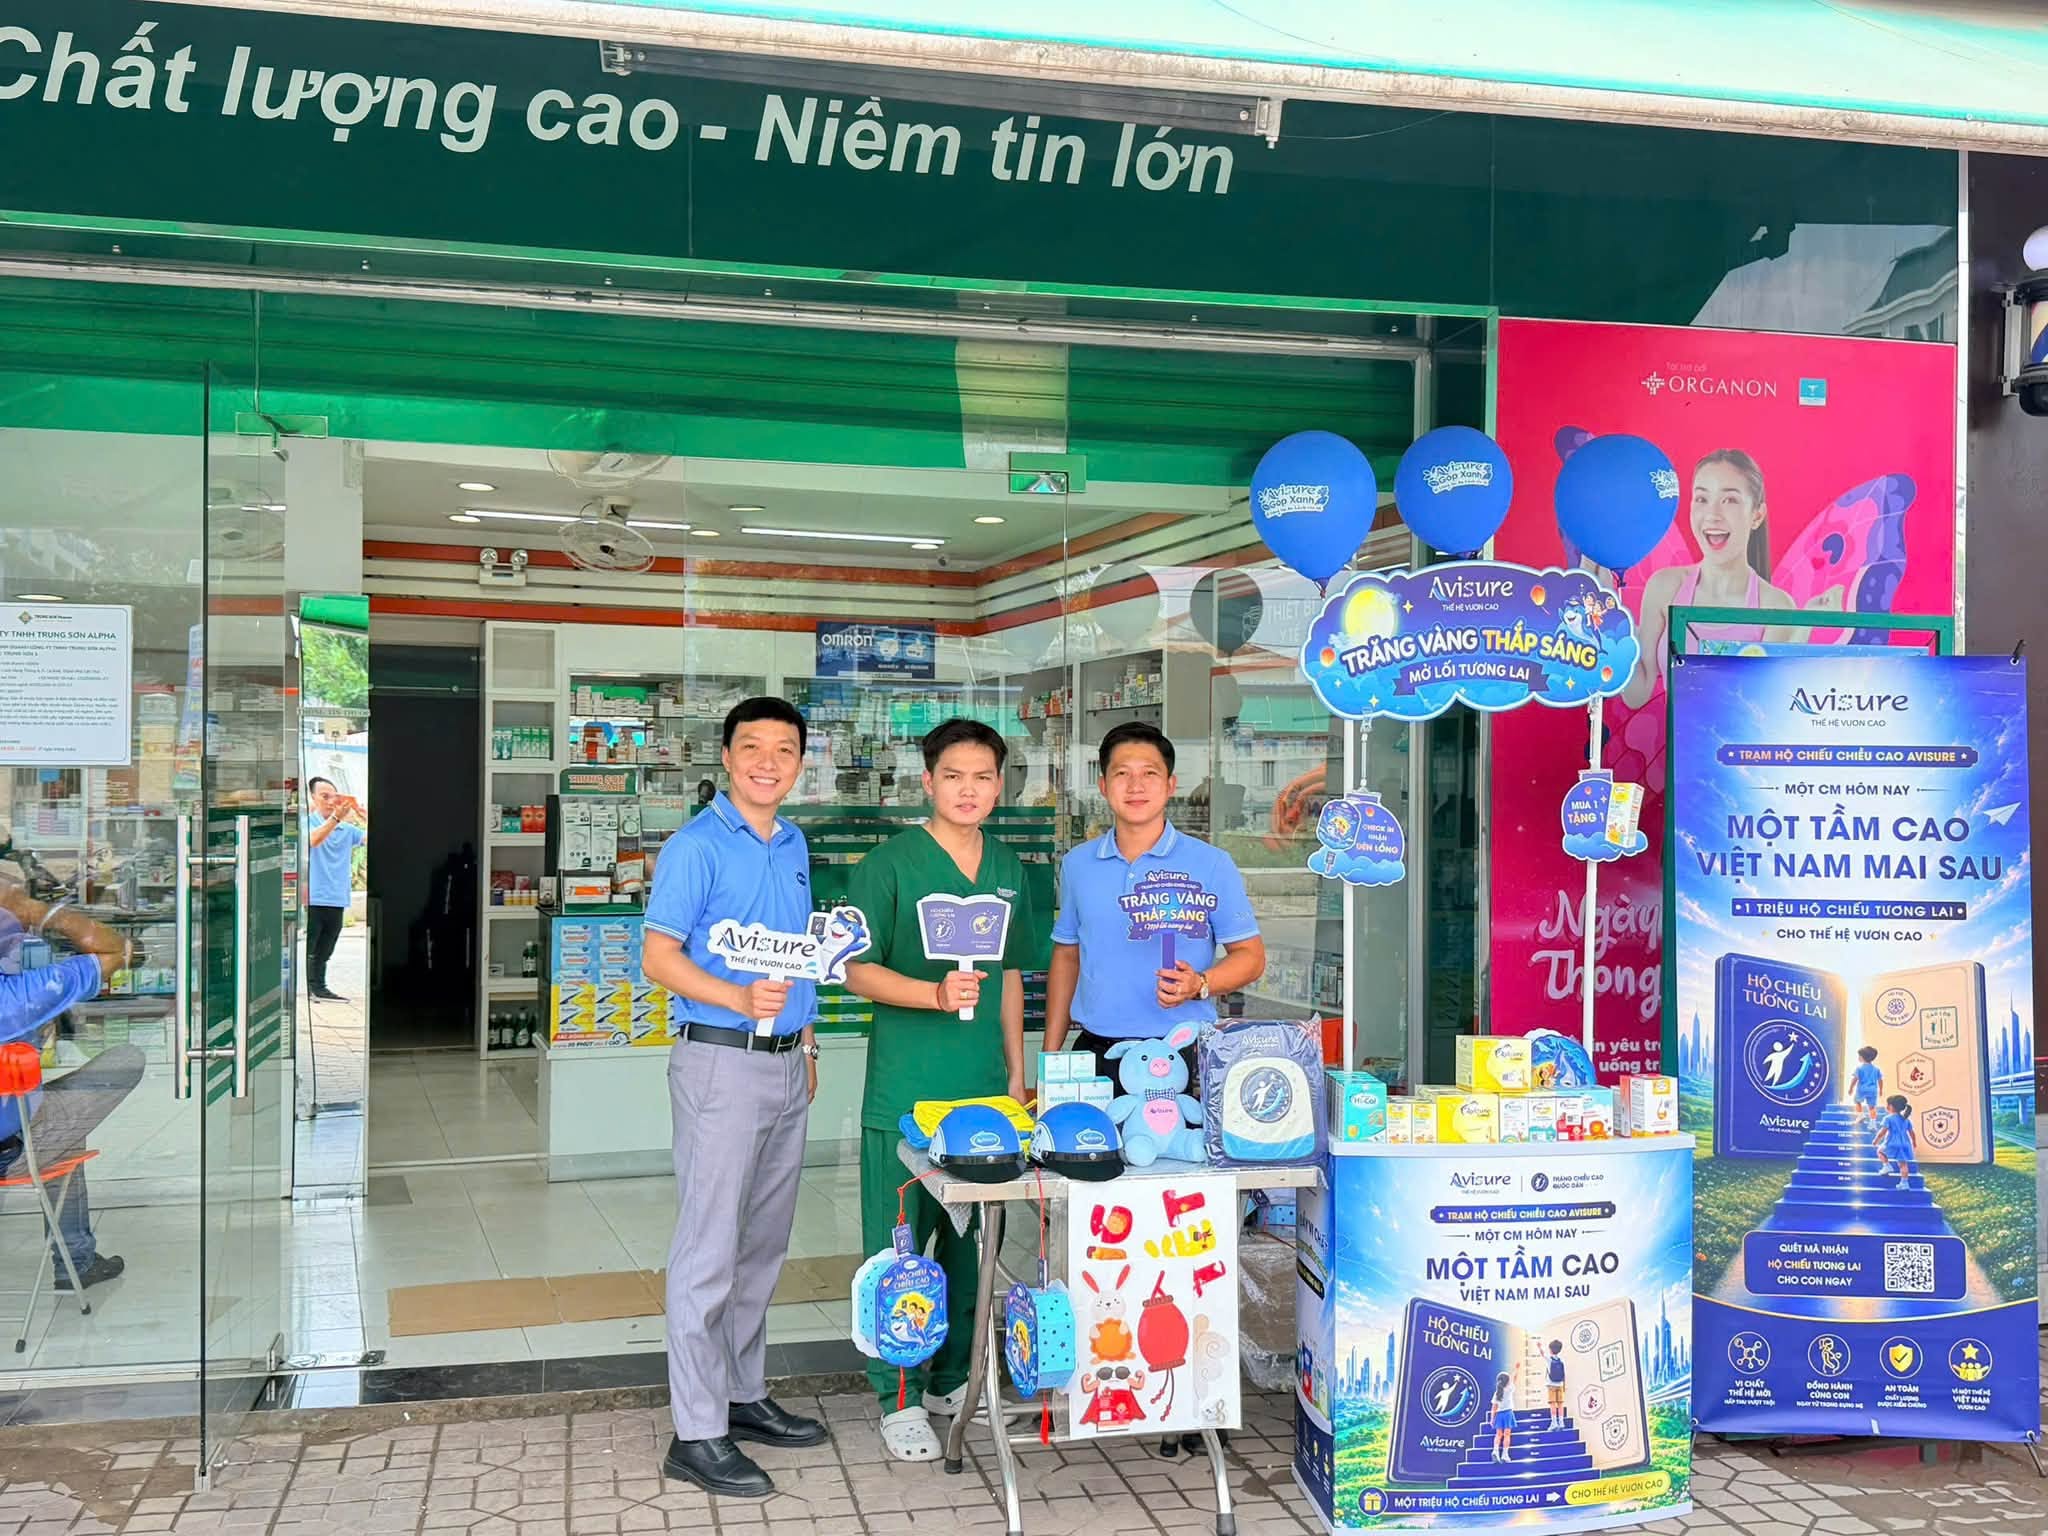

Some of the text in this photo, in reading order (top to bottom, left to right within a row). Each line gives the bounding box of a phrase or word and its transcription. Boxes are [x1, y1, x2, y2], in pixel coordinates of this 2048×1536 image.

[0, 21, 1236, 195] Chất lượng cao - Niềm tin lớn
[1668, 375, 1777, 397] ORGANON
[1428, 575, 1514, 601] Avisure
[1341, 619, 1597, 674] TRĂNG VÀNG THẤP SÁNG
[1409, 659, 1530, 683] MỞ LỐI TƯƠNG LAI
[1788, 687, 1910, 715] Avisure
[1740, 747, 1956, 763] TRẠM HỘ CHIẾU CHIỀU CAO AVISURE
[1784, 781, 1910, 798] MỘT CM HÔM NAY
[1571, 799, 1599, 810] MUA 1
[1567, 811, 1605, 826] TẶNG 1
[1727, 803, 1970, 847] MỘT TẦM CAO
[1695, 846, 2002, 884] VIỆT NAM MAI SAU
[1147, 870, 1189, 882] Avisure
[1120, 891, 1217, 909] TRĂNG VÀNG
[1745, 901, 1953, 918] 1 TRIỆU HỘ CHIẾU TƯƠNG LAI
[716, 926, 816, 958] Avisure
[1776, 926, 1923, 943] CHO THẾ HỆ VƯƠN CAO
[730, 954, 802, 971] THẾ HỆ VƯƠN CAO
[1747, 972, 1822, 1001] HỘ CHIẾU
[1742, 989, 1827, 1019] TƯƠNG LAI
[1610, 1037, 1641, 1055] yêu
[1600, 1056, 1641, 1073] uống
[1759, 1113, 1810, 1129] Avisure
[1449, 1171, 1512, 1189] Avisure
[1448, 1207, 1602, 1222] TRẠM HỘ CHIẾU CHIỀU CAO AVISURE
[1475, 1227, 1578, 1244] MỘT CM HÔM NAY
[1779, 1242, 1802, 1253] QUÉT
[1822, 1243, 1849, 1256] NHẬN
[1426, 1244, 1620, 1287] MỘT TẦM CAO
[1767, 1258, 1861, 1272] HỘ CHIẾU TƯƠNG LAI
[1777, 1275, 1853, 1287] CHO CON NGAY
[1459, 1284, 1590, 1305] VIỆT NAM MAI SAU
[1428, 1315, 1490, 1343] HỘ CHIẾU
[1423, 1330, 1492, 1361] TƯƠNG LAI
[1884, 1383, 1919, 1393] AN TOÀN
[1952, 1395, 1991, 1404] VIỆT NAM
[1419, 1434, 1465, 1449] Avisure
[1571, 1479, 1664, 1499] CHO THẾ HỆ VƯƠN CAO
[1395, 1493, 1540, 1509] MỘT TRIỆU HỘ CHIẾU TƯƠNG LAI
